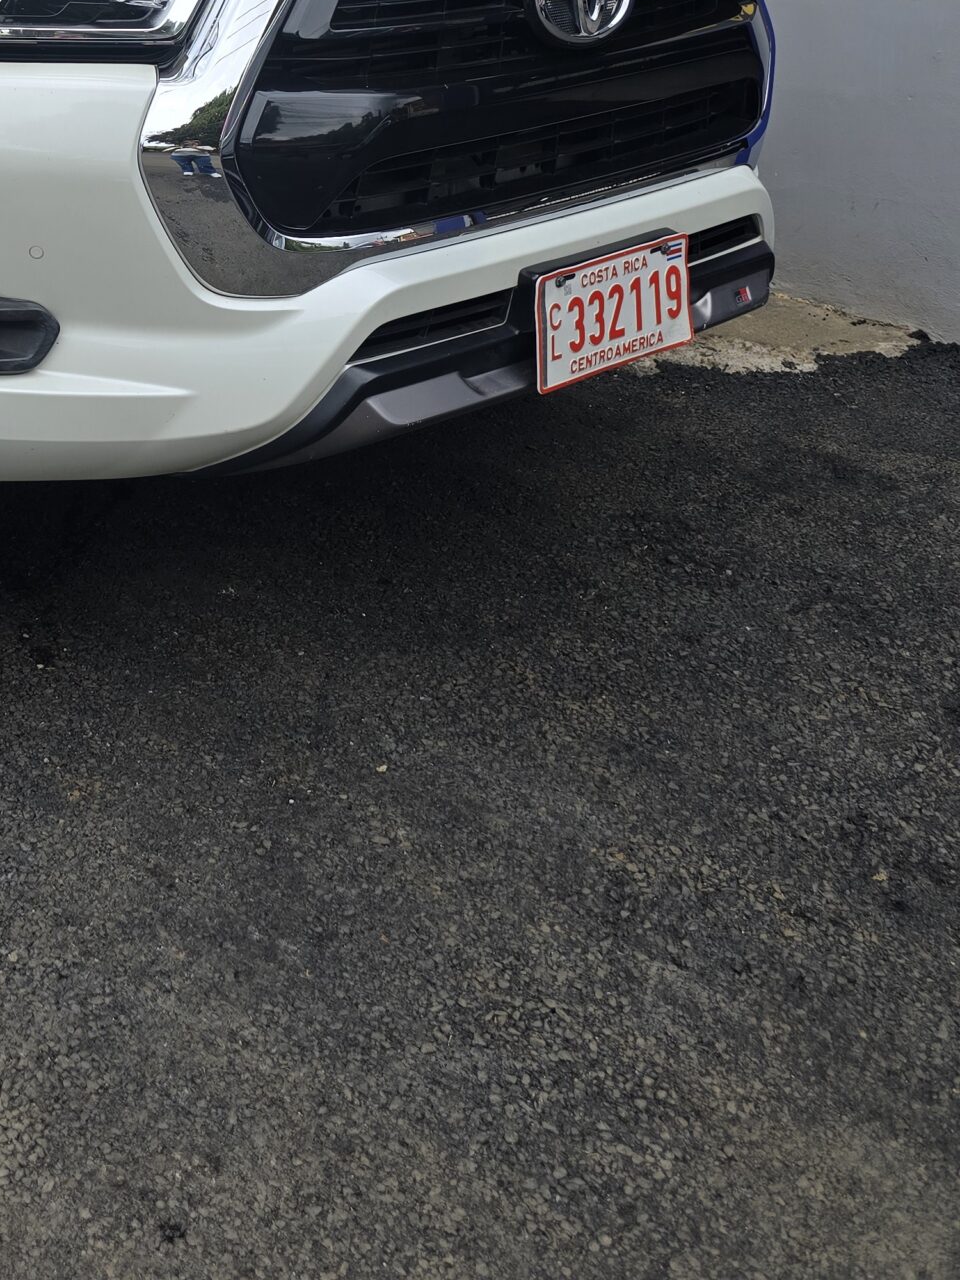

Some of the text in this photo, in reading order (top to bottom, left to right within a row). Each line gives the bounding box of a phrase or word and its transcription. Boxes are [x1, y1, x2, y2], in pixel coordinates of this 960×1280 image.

[580, 254, 648, 288] COSTA RICA
[567, 264, 682, 353] 332119
[570, 330, 664, 375] CENTROAMERICA
